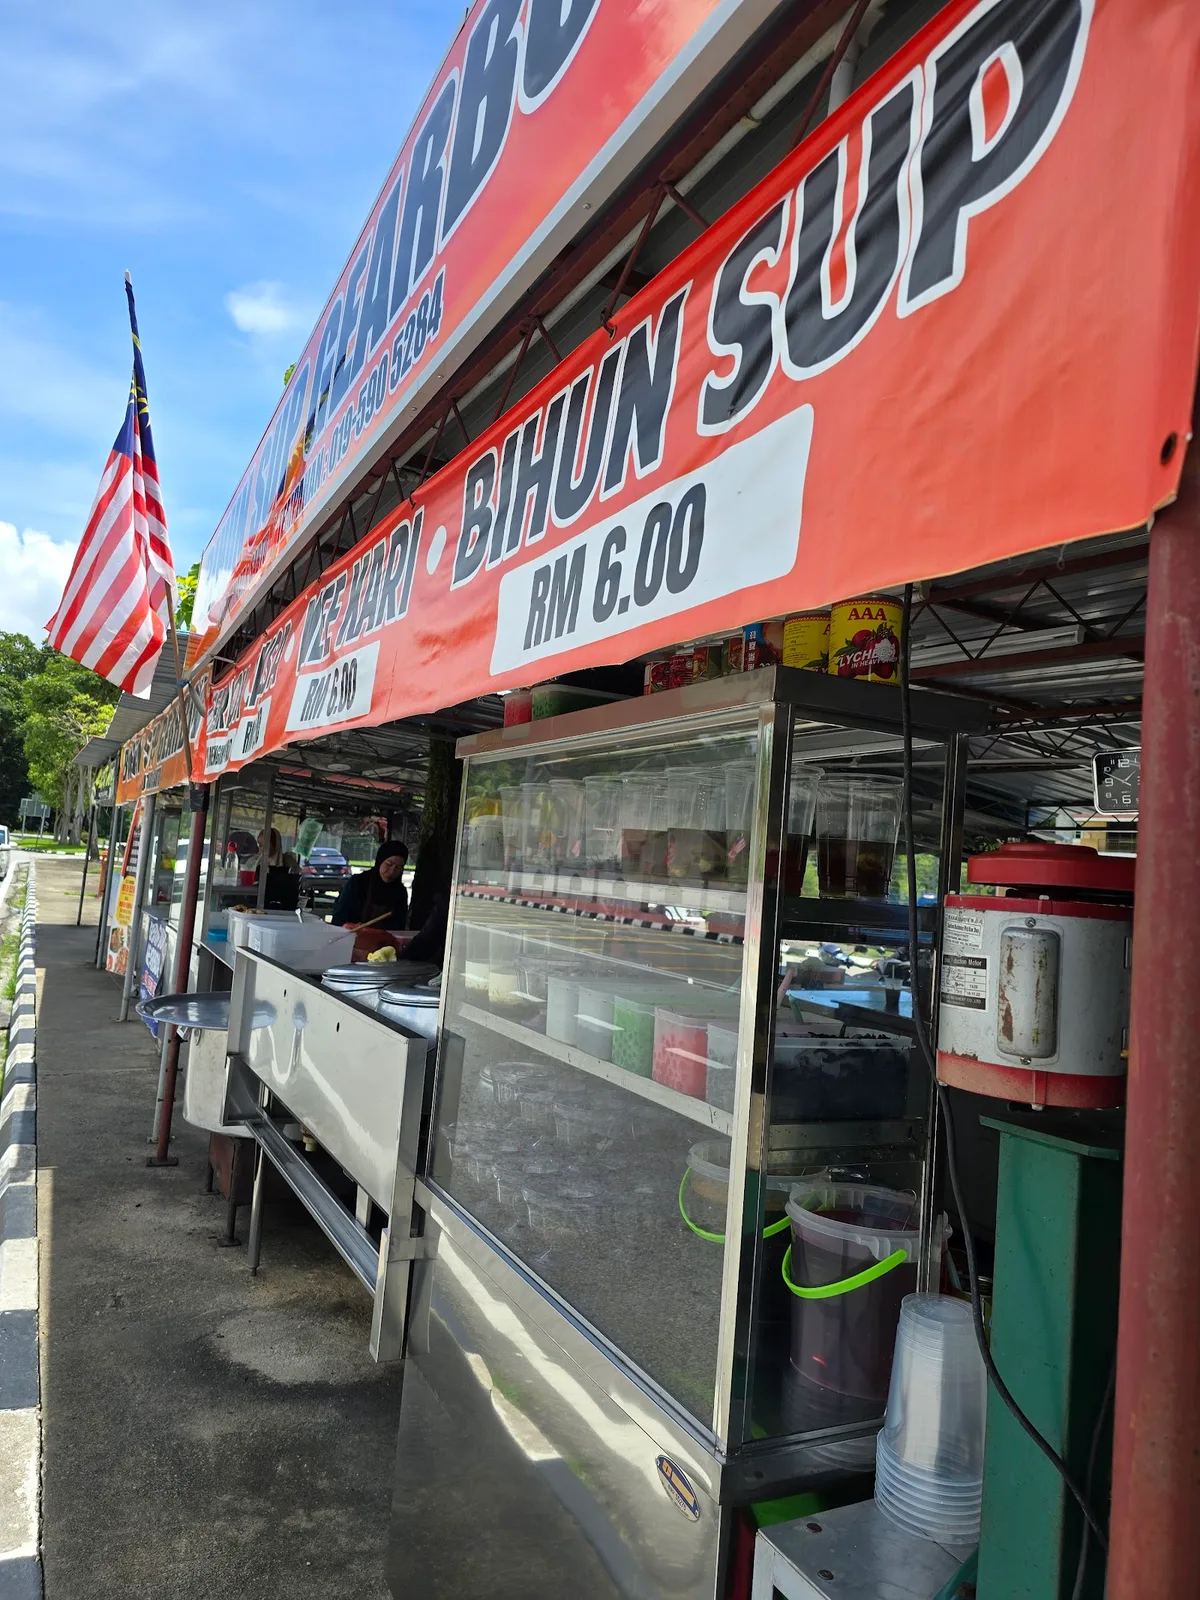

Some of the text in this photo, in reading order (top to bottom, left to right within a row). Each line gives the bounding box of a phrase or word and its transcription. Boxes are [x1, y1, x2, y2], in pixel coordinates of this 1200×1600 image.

[450, 0, 1096, 591] BIHUN SUP
[389, 264, 447, 395] 5284
[334, 505, 425, 652] KARI
[523, 482, 707, 650] RM 6.00
[847, 607, 888, 621] AAA
[300, 669, 332, 723] RM
[327, 657, 359, 717] 6.00
[1104, 777, 1114, 787] 9
[1117, 758, 1130, 768] 12
[1121, 794, 1132, 804] 6
